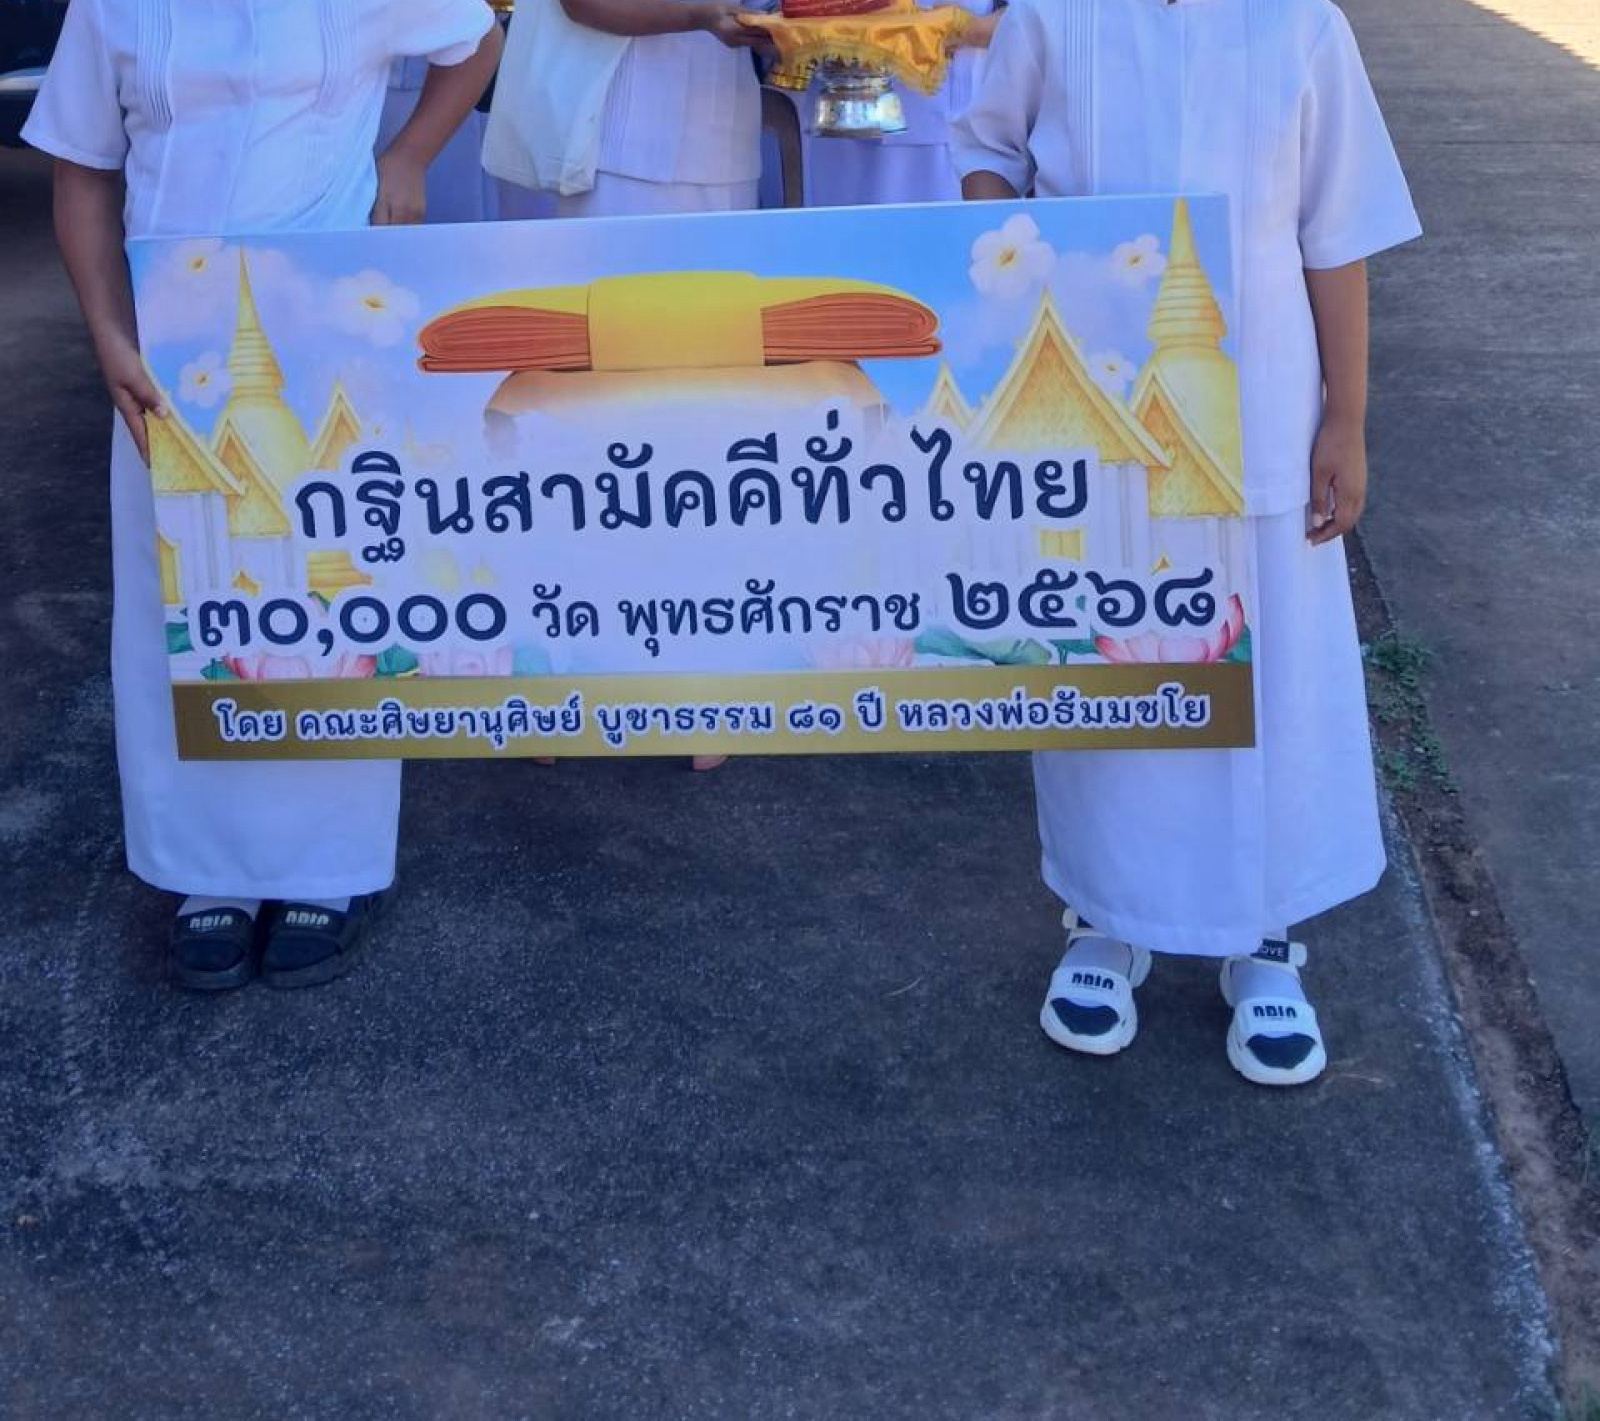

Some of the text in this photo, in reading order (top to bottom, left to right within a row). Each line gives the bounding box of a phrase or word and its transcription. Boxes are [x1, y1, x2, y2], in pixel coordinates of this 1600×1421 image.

[295, 409, 1088, 563] กฐินสามัคคีทั่วไทย
[199, 566, 1217, 657] ๓๐,๐๐๐ วัด พุทธศักราช ๒๕๖๘
[216, 686, 1206, 746] โดย คณะศิษยานุศิษย์ บูชาธรรม ๘๑ ปี หลวงพ่อธัมมชโย
